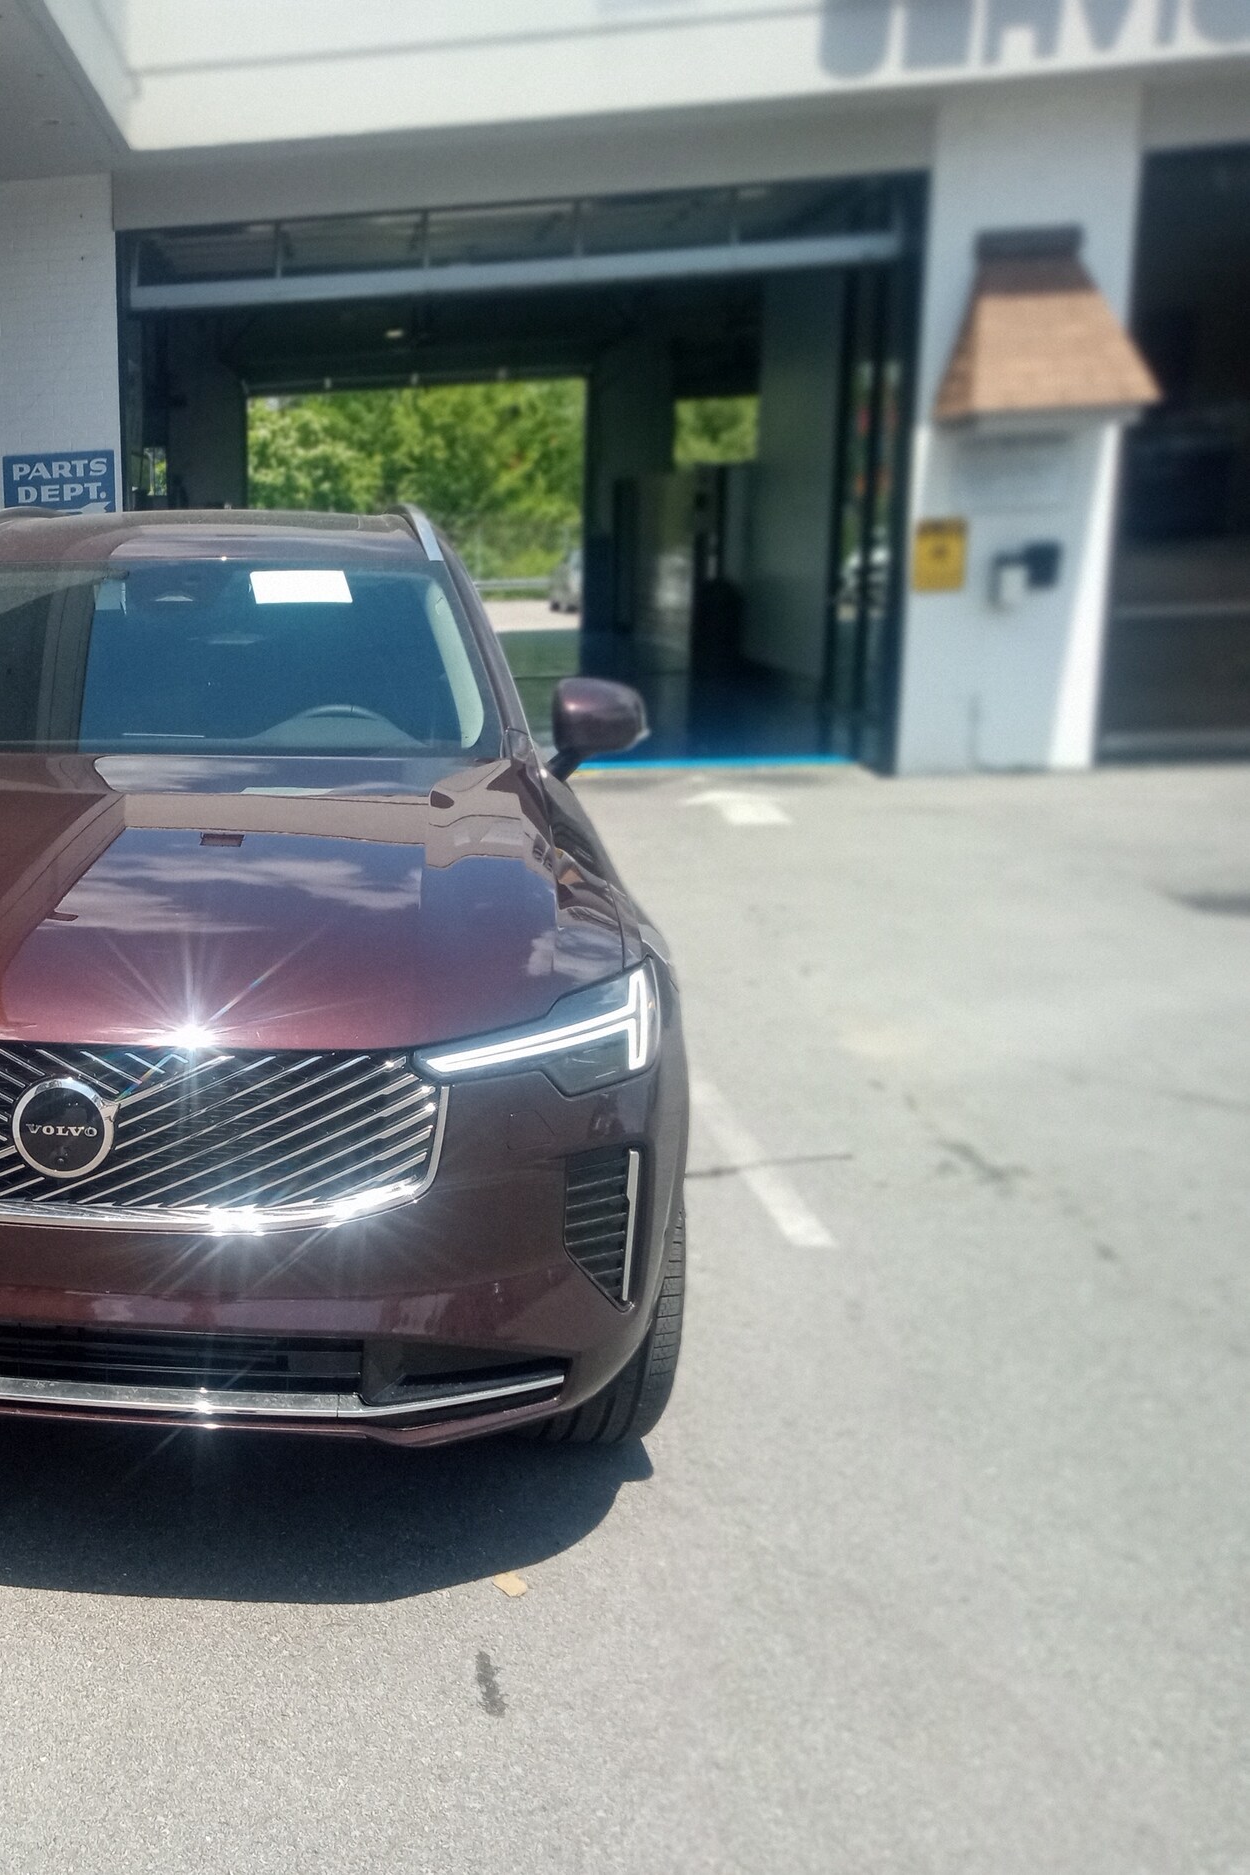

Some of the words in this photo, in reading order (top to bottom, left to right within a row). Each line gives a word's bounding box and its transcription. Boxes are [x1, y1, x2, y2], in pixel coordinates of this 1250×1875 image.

[12, 457, 108, 481] PARTS
[17, 482, 107, 504] DEPT.
[25, 1123, 98, 1137] VOLVO
